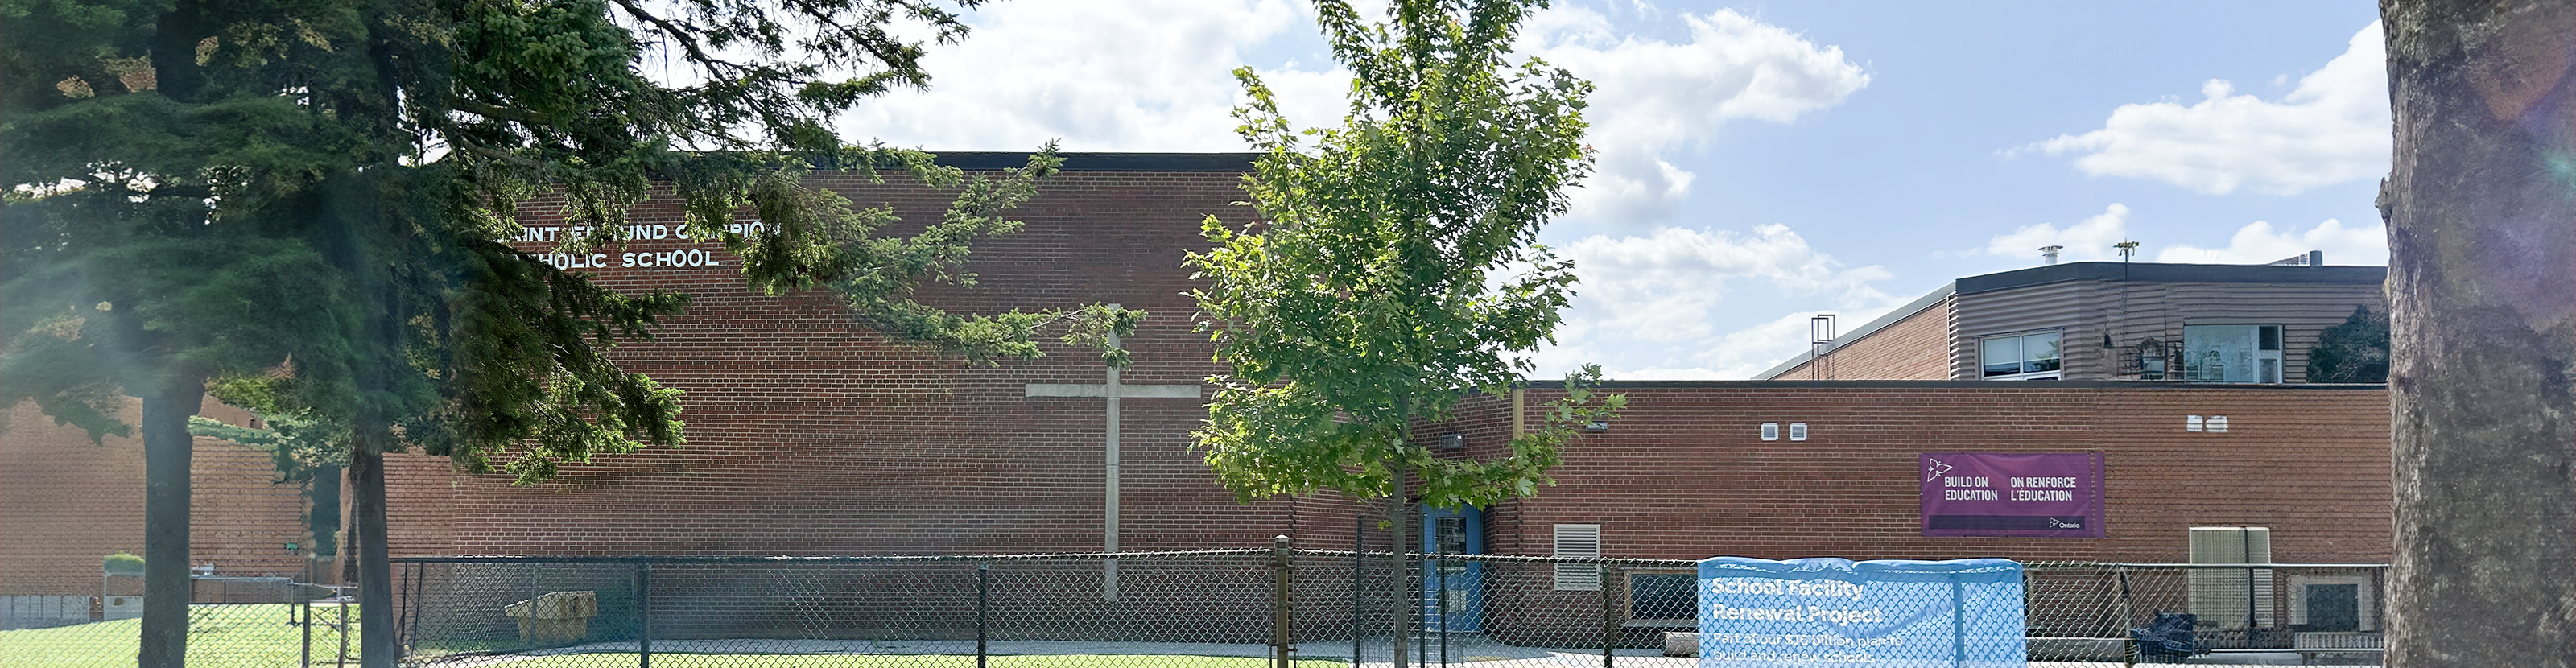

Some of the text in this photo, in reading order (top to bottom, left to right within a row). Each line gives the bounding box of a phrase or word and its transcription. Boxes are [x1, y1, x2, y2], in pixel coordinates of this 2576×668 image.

[495, 221, 781, 242] INT EUND CPION
[512, 249, 720, 270] HOLIC SCHOOL
[1945, 476, 1988, 488] BUILD ON
[2010, 476, 2077, 488] ON RENFORCE
[1945, 489, 1998, 501] EDUCATION
[2010, 488, 2073, 501] L'ÉDUCATION
[1711, 577, 1864, 601] School Facility
[1712, 604, 1884, 627] Renewal Project
[1713, 632, 1740, 644] Part
[1743, 633, 1757, 644] of
[1760, 635, 1782, 645] our
[1812, 634, 1853, 646] billion
[1857, 636, 1886, 649] plan
[1890, 637, 1902, 645] to
[1713, 649, 1875, 662] build and renew schools
